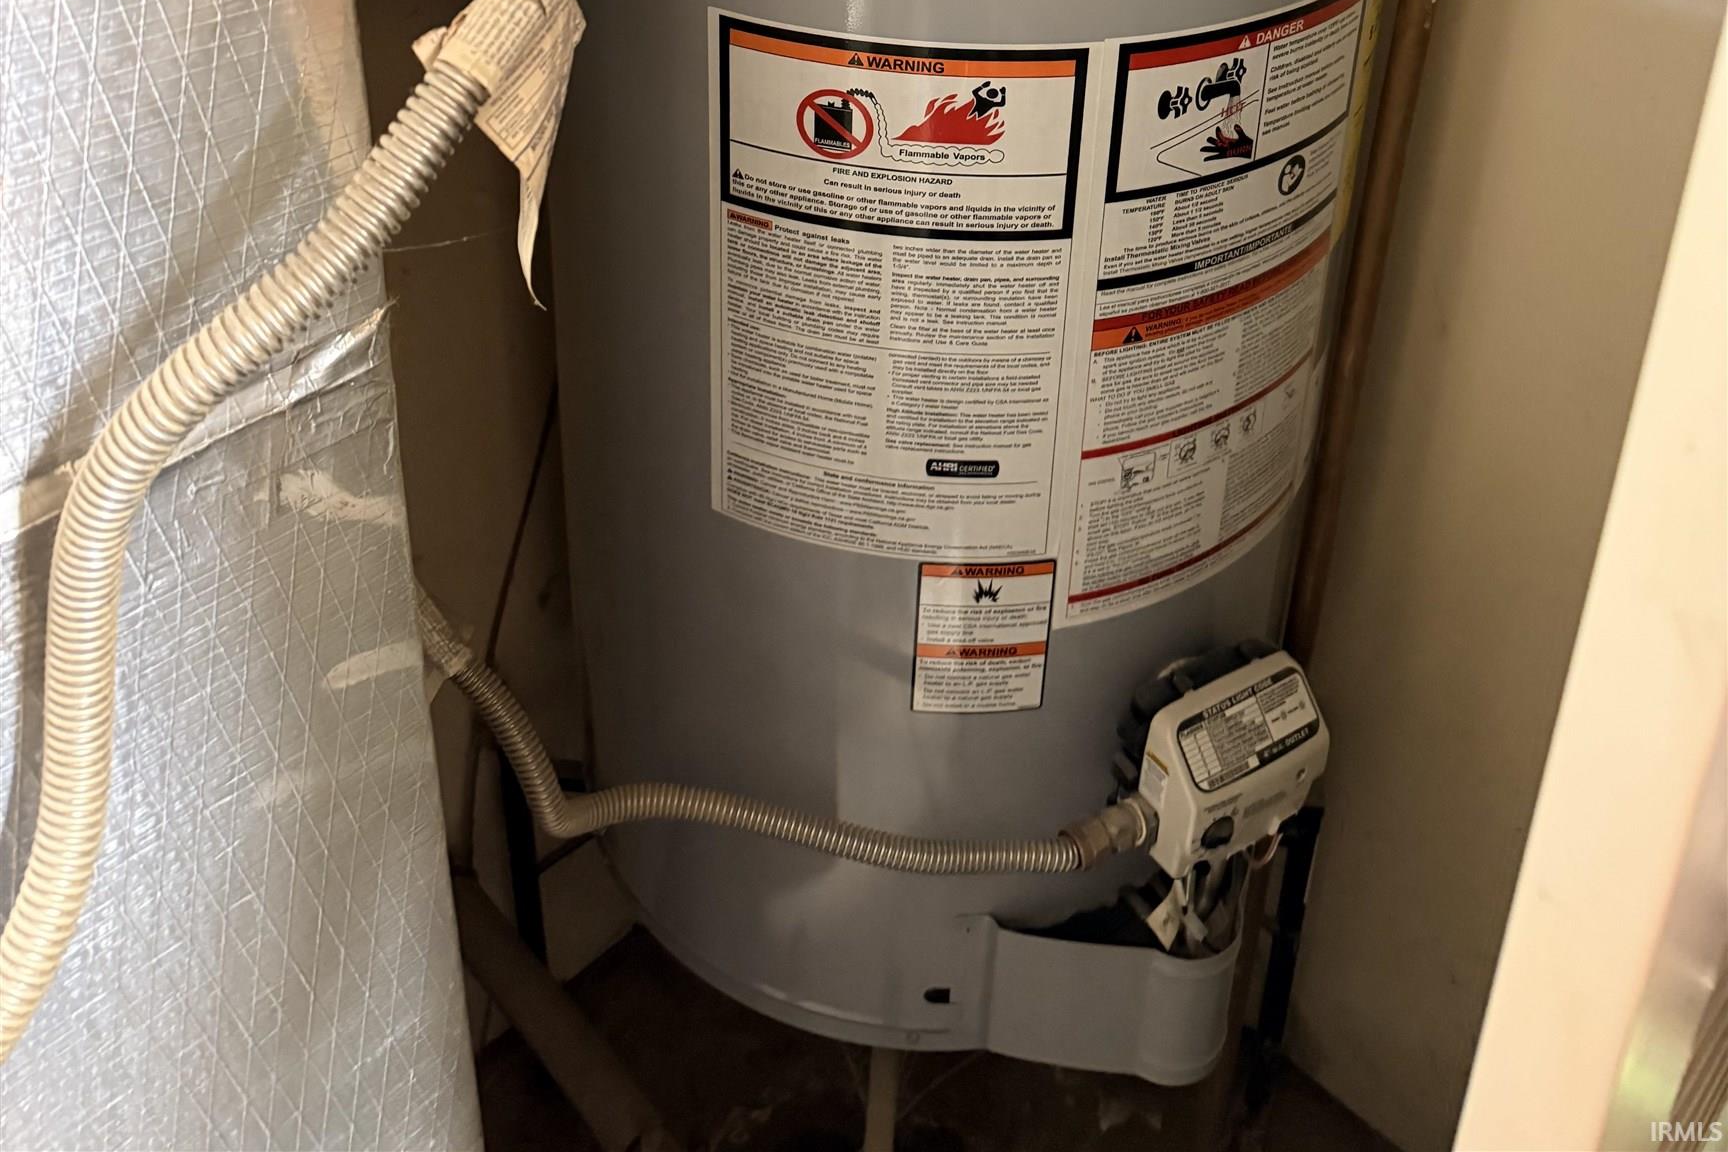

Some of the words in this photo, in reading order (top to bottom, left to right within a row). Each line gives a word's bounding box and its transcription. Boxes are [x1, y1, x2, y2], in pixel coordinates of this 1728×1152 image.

[1256, 19, 1304, 45] DANGER
[867, 56, 944, 74] WARNING
[815, 137, 851, 148] FLAMMABLES
[899, 149, 950, 160] Flammable
[953, 152, 986, 162] Vapors
[832, 167, 851, 176] FIRE
[852, 170, 869, 178] AND
[871, 173, 917, 183] EXPLOSION
[919, 177, 953, 186] HAZARD
[744, 173, 755, 182] Do
[755, 176, 767, 186] not
[768, 181, 787, 189] store
[812, 189, 844, 201] gasoline
[856, 197, 877, 205] other
[878, 198, 918, 209] flammable
[965, 205, 992, 213] liquids
[1018, 205, 1045, 213] vicinity
[823, 179, 839, 187] Can
[840, 181, 863, 190] result
[873, 186, 902, 195] serious
[904, 189, 927, 198] injury
[732, 178, 745, 188] this
[755, 185, 768, 195] any
[769, 189, 788, 198] other
[790, 193, 826, 206] appliance.
[828, 200, 858, 212] Storage
[905, 211, 938, 220] gasoline
[1015, 214, 1041, 222] vapors
[1122, 203, 1166, 215] TEMPERATURE
[1146, 195, 1167, 205] WATER
[756, 192, 763, 200] in
[764, 194, 776, 203] the
[777, 198, 803, 210] vicinity
[814, 205, 827, 214] this
[839, 211, 853, 219] any
[855, 212, 875, 221] other
[876, 215, 914, 226] appliance
[932, 220, 954, 228] result
[997, 222, 1019, 230] injury
[774, 224, 800, 235] Protect
[802, 231, 828, 242] against
[831, 236, 850, 245] leaks
[1104, 254, 1126, 263] Install
[1127, 247, 1169, 259] Thermostatic
[1170, 241, 1191, 250] Mixing
[1191, 237, 1211, 246] Valves
[1194, 224, 1292, 270] IMPORTANT/IMPORTANTE
[964, 566, 1025, 576] WARNING
[959, 646, 1018, 657] WARNING
